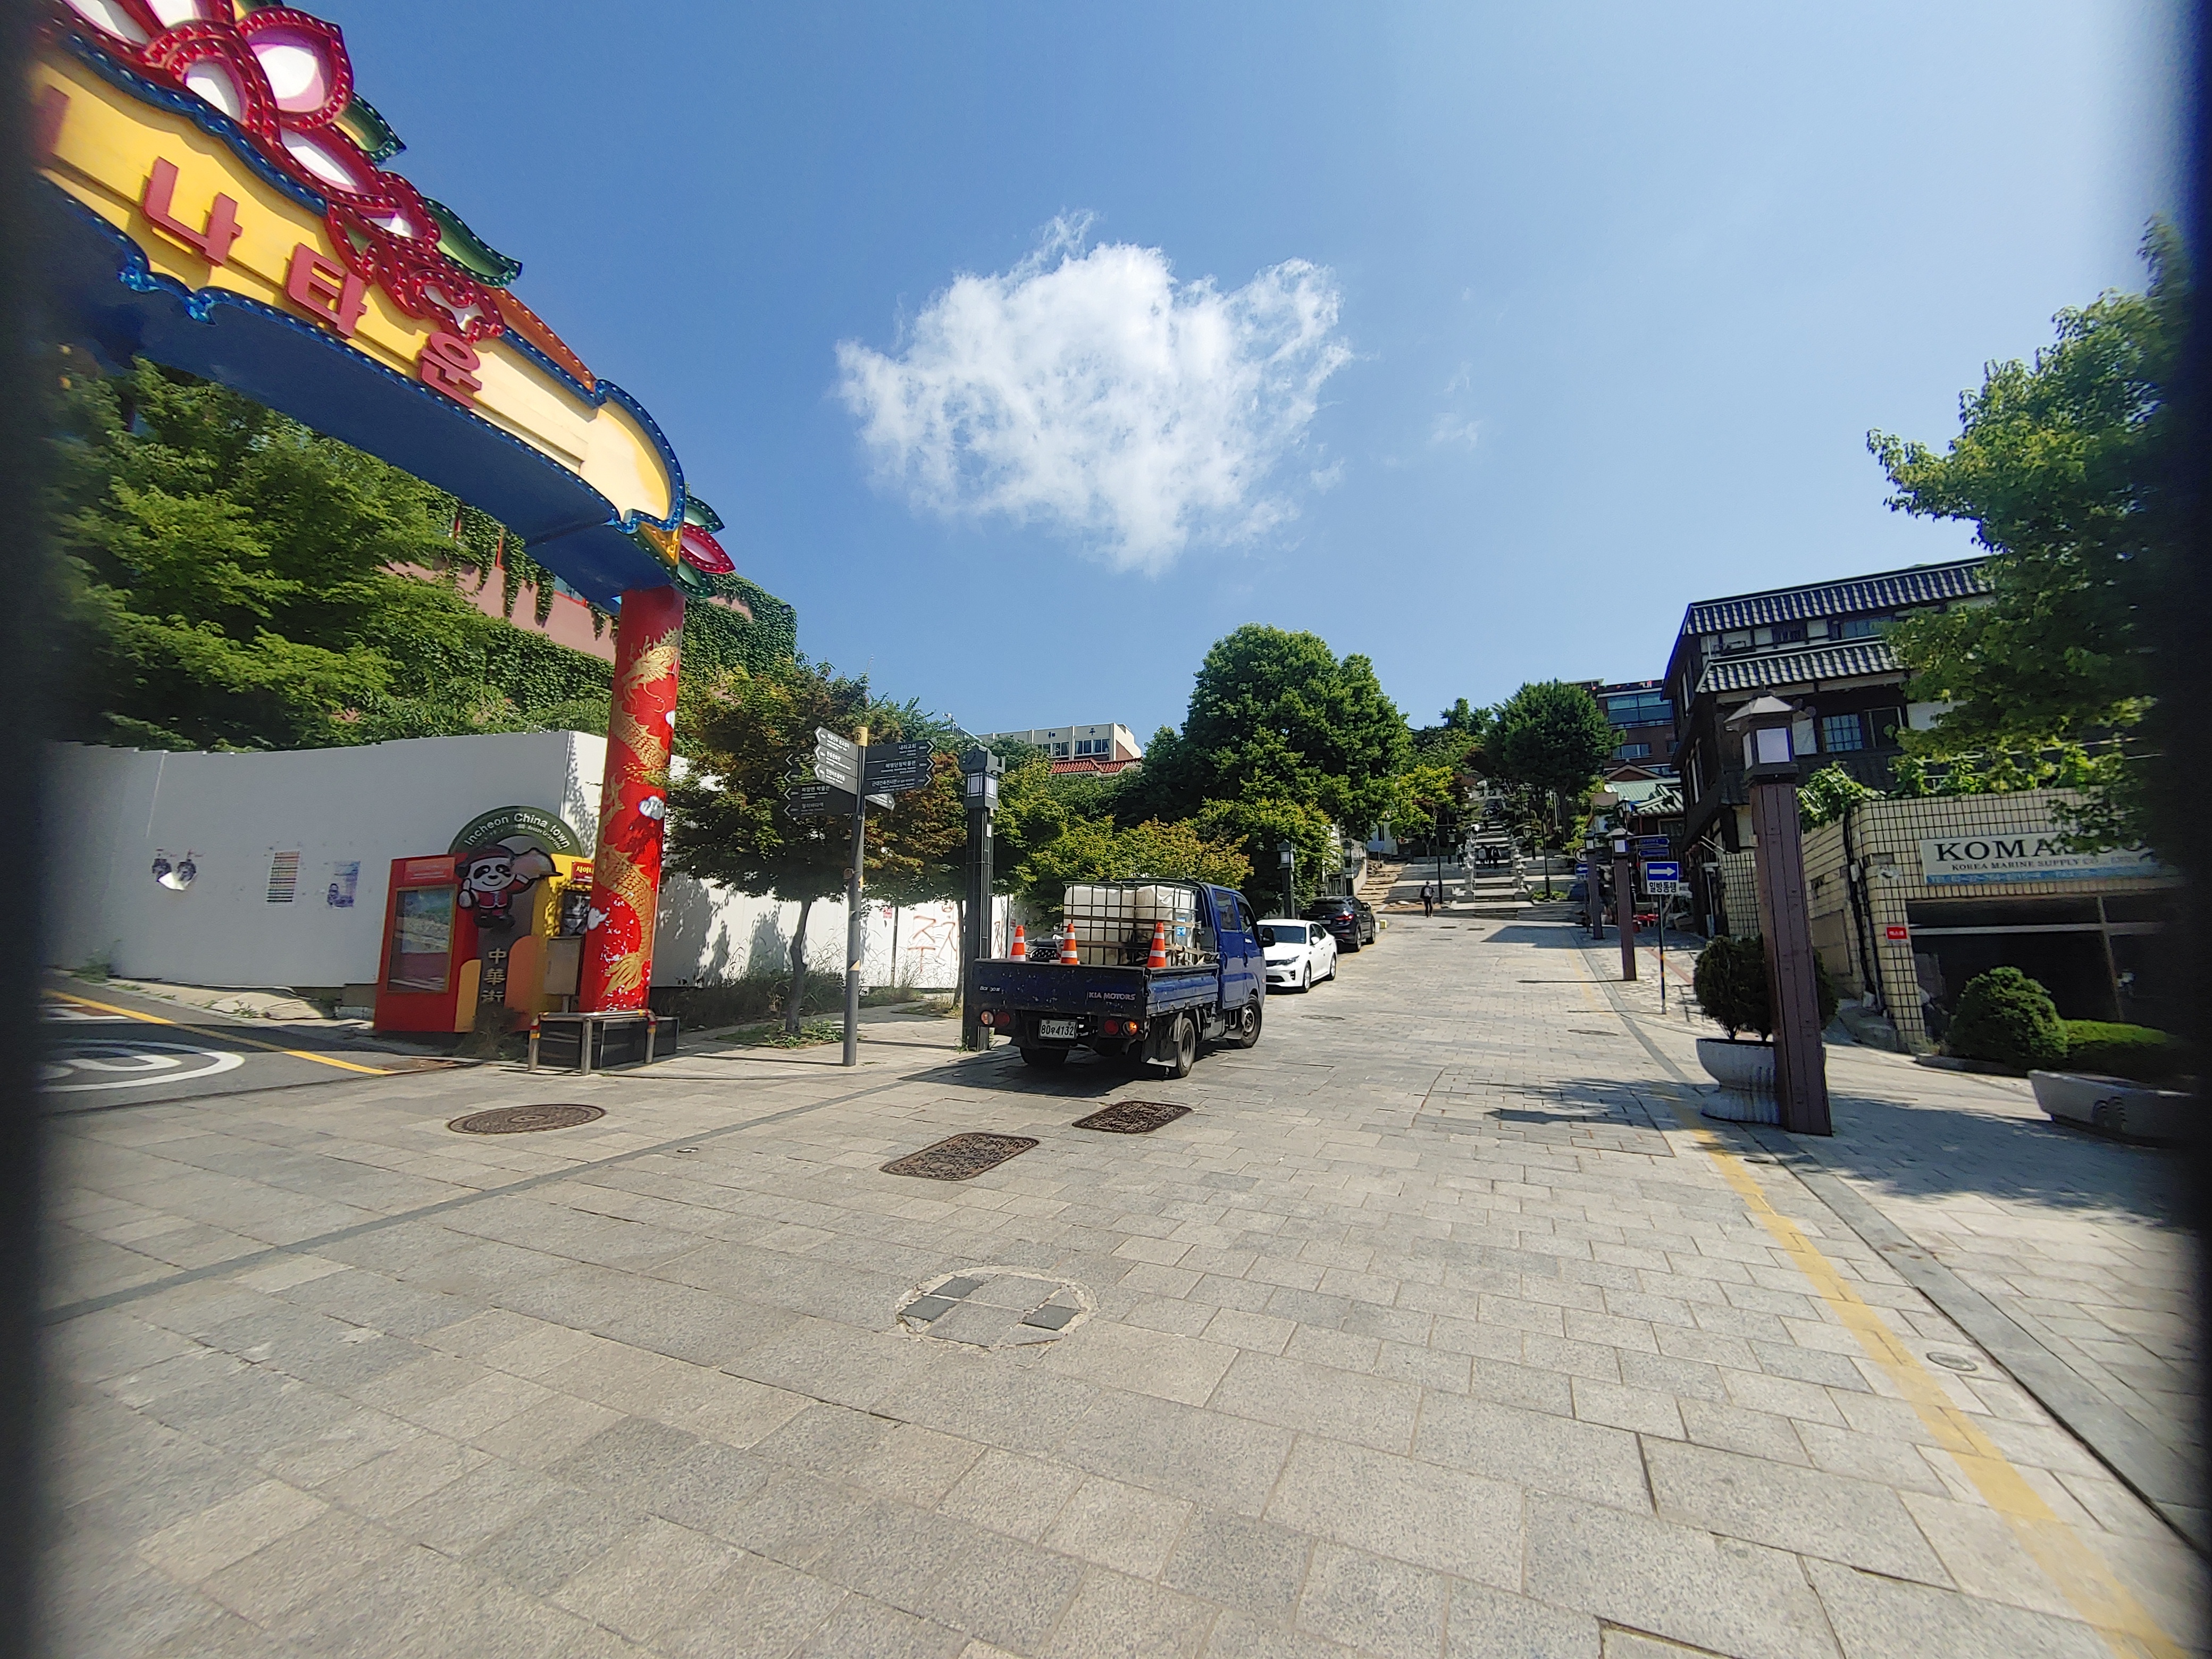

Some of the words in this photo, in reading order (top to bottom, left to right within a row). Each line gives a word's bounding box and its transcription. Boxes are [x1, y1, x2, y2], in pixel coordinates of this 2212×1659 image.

[464, 815, 509, 846] Incheon
[514, 812, 548, 828] China
[550, 824, 571, 849] town
[2038, 858, 2079, 867] SUPPLY
[1649, 882, 1677, 893] 일방통행
[1103, 992, 1136, 1001] MOTORS
